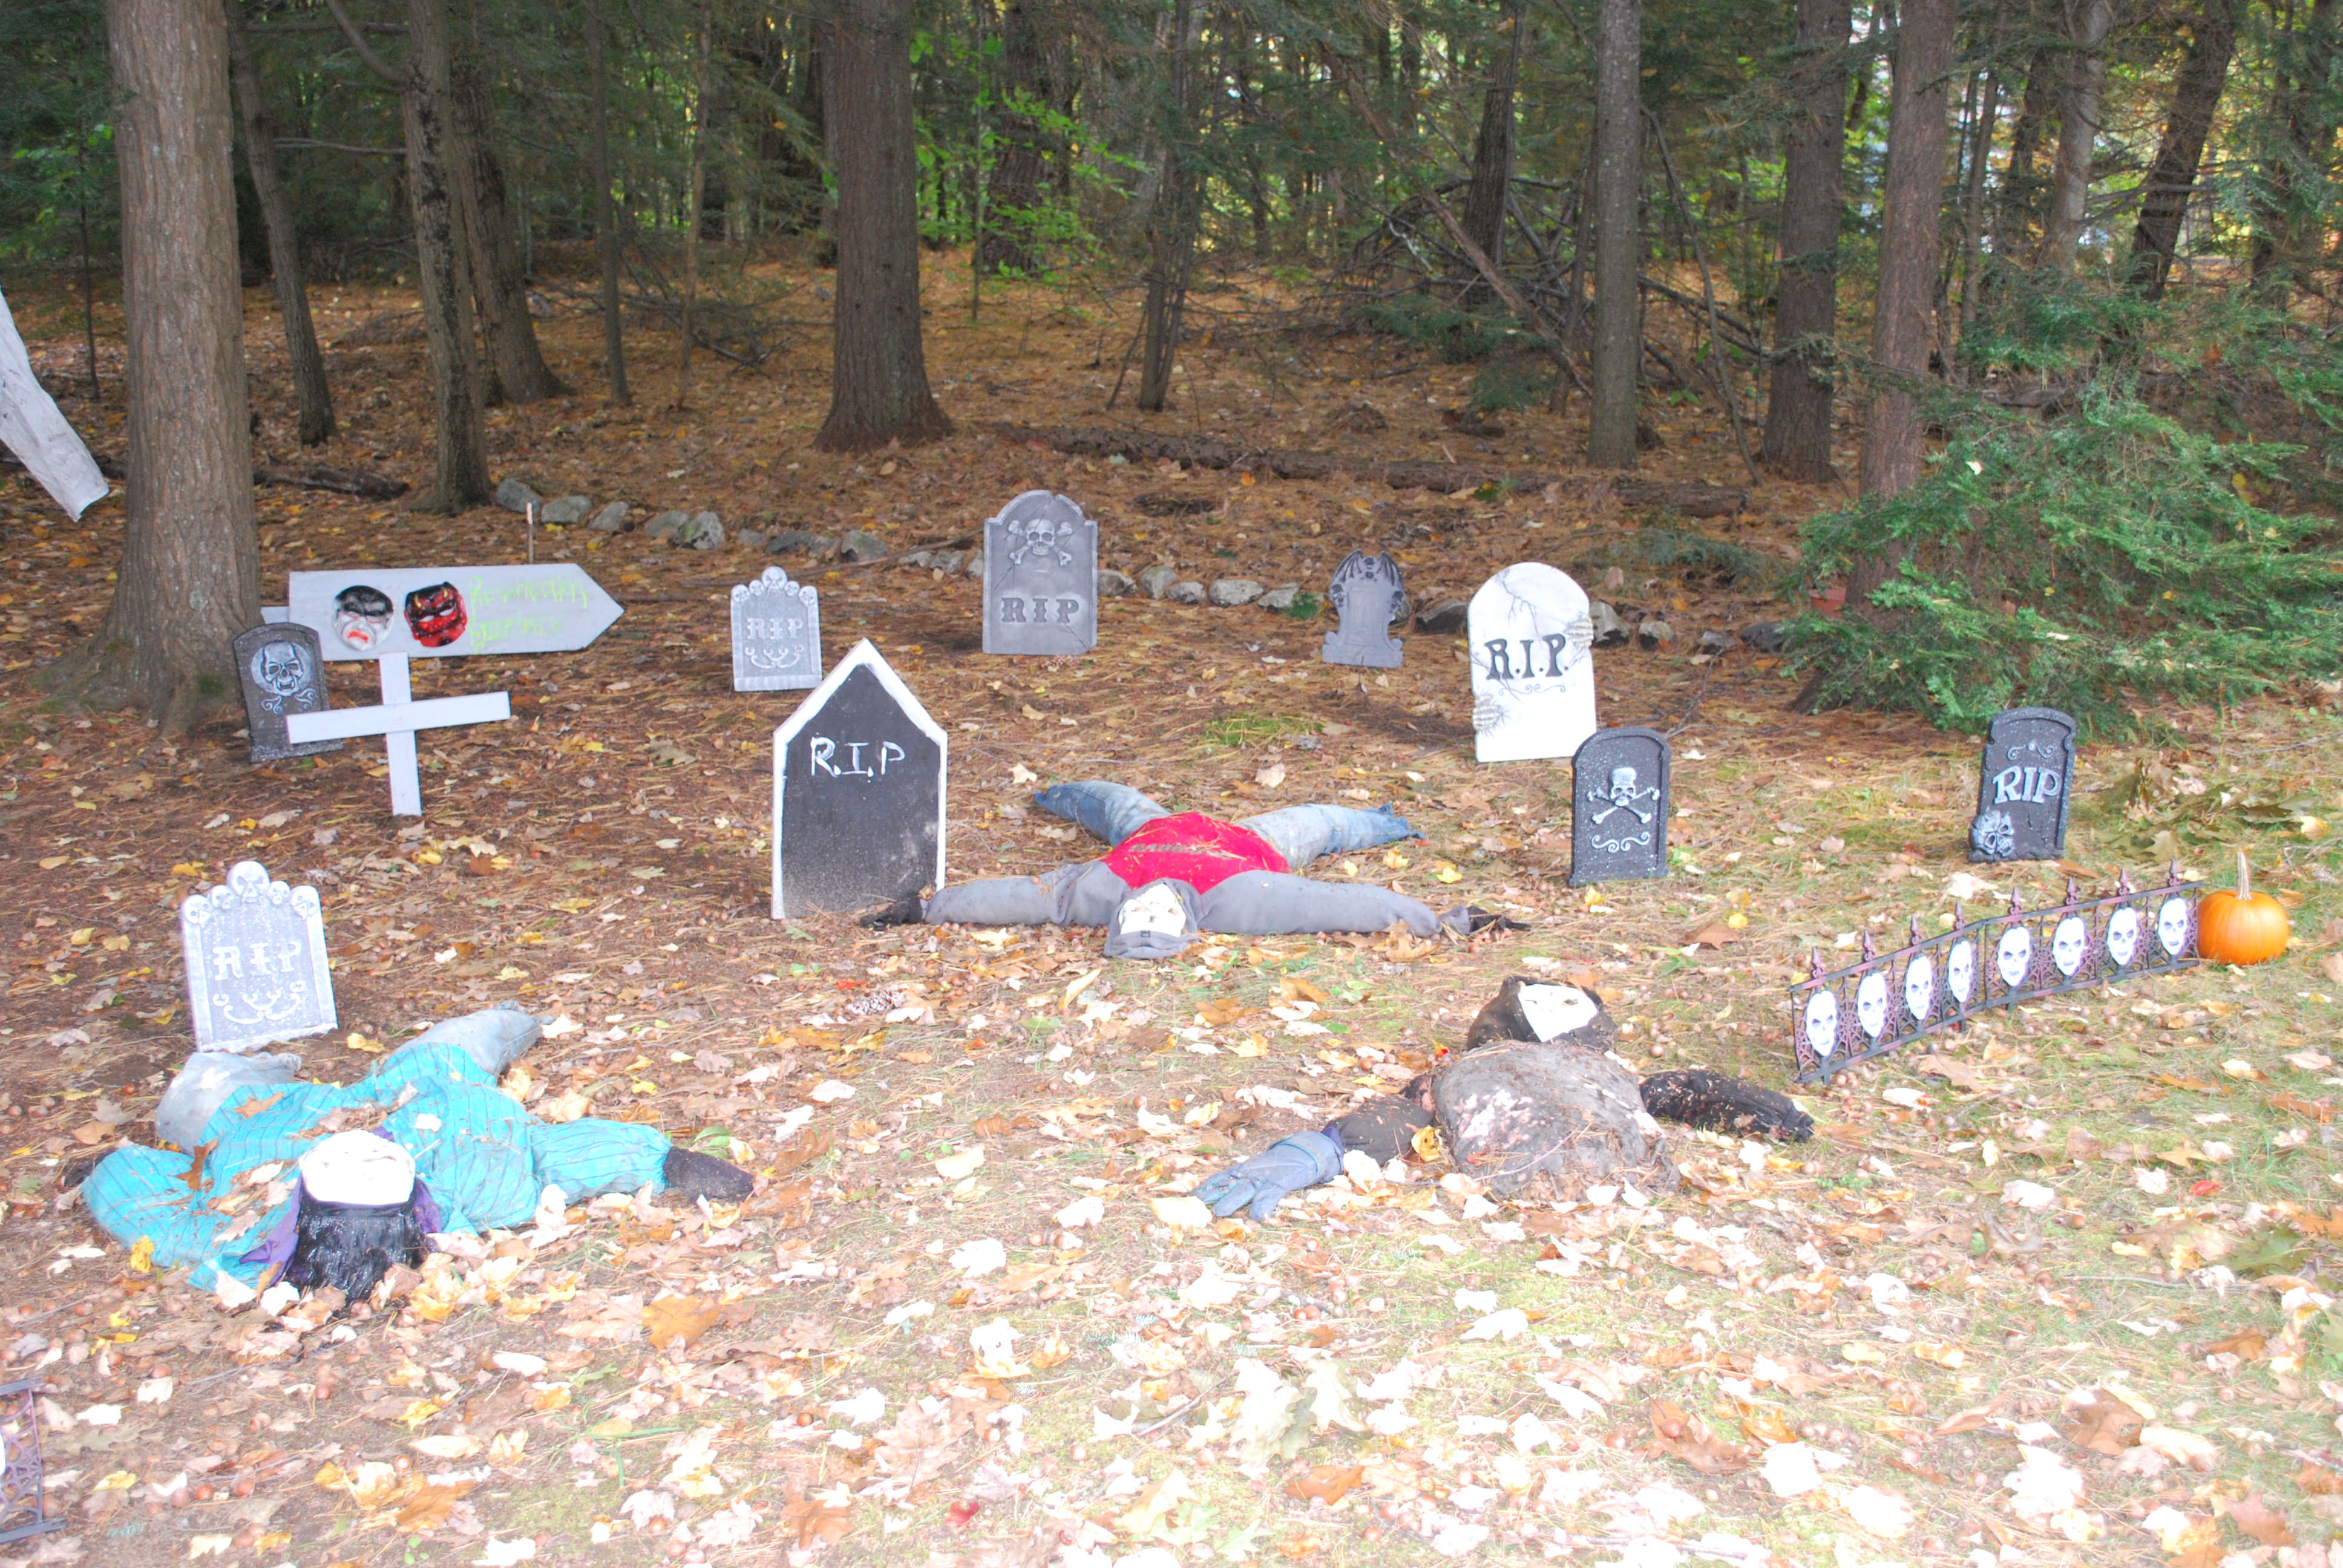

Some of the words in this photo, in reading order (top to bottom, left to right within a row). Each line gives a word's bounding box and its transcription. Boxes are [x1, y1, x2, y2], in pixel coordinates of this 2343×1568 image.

[746, 617, 804, 640] RIP
[1000, 596, 1080, 623] RIP
[1484, 633, 1570, 681] R.I.P.
[810, 736, 905, 779] R.I.P
[1992, 765, 2062, 805] RIP
[212, 941, 303, 981] RIP
